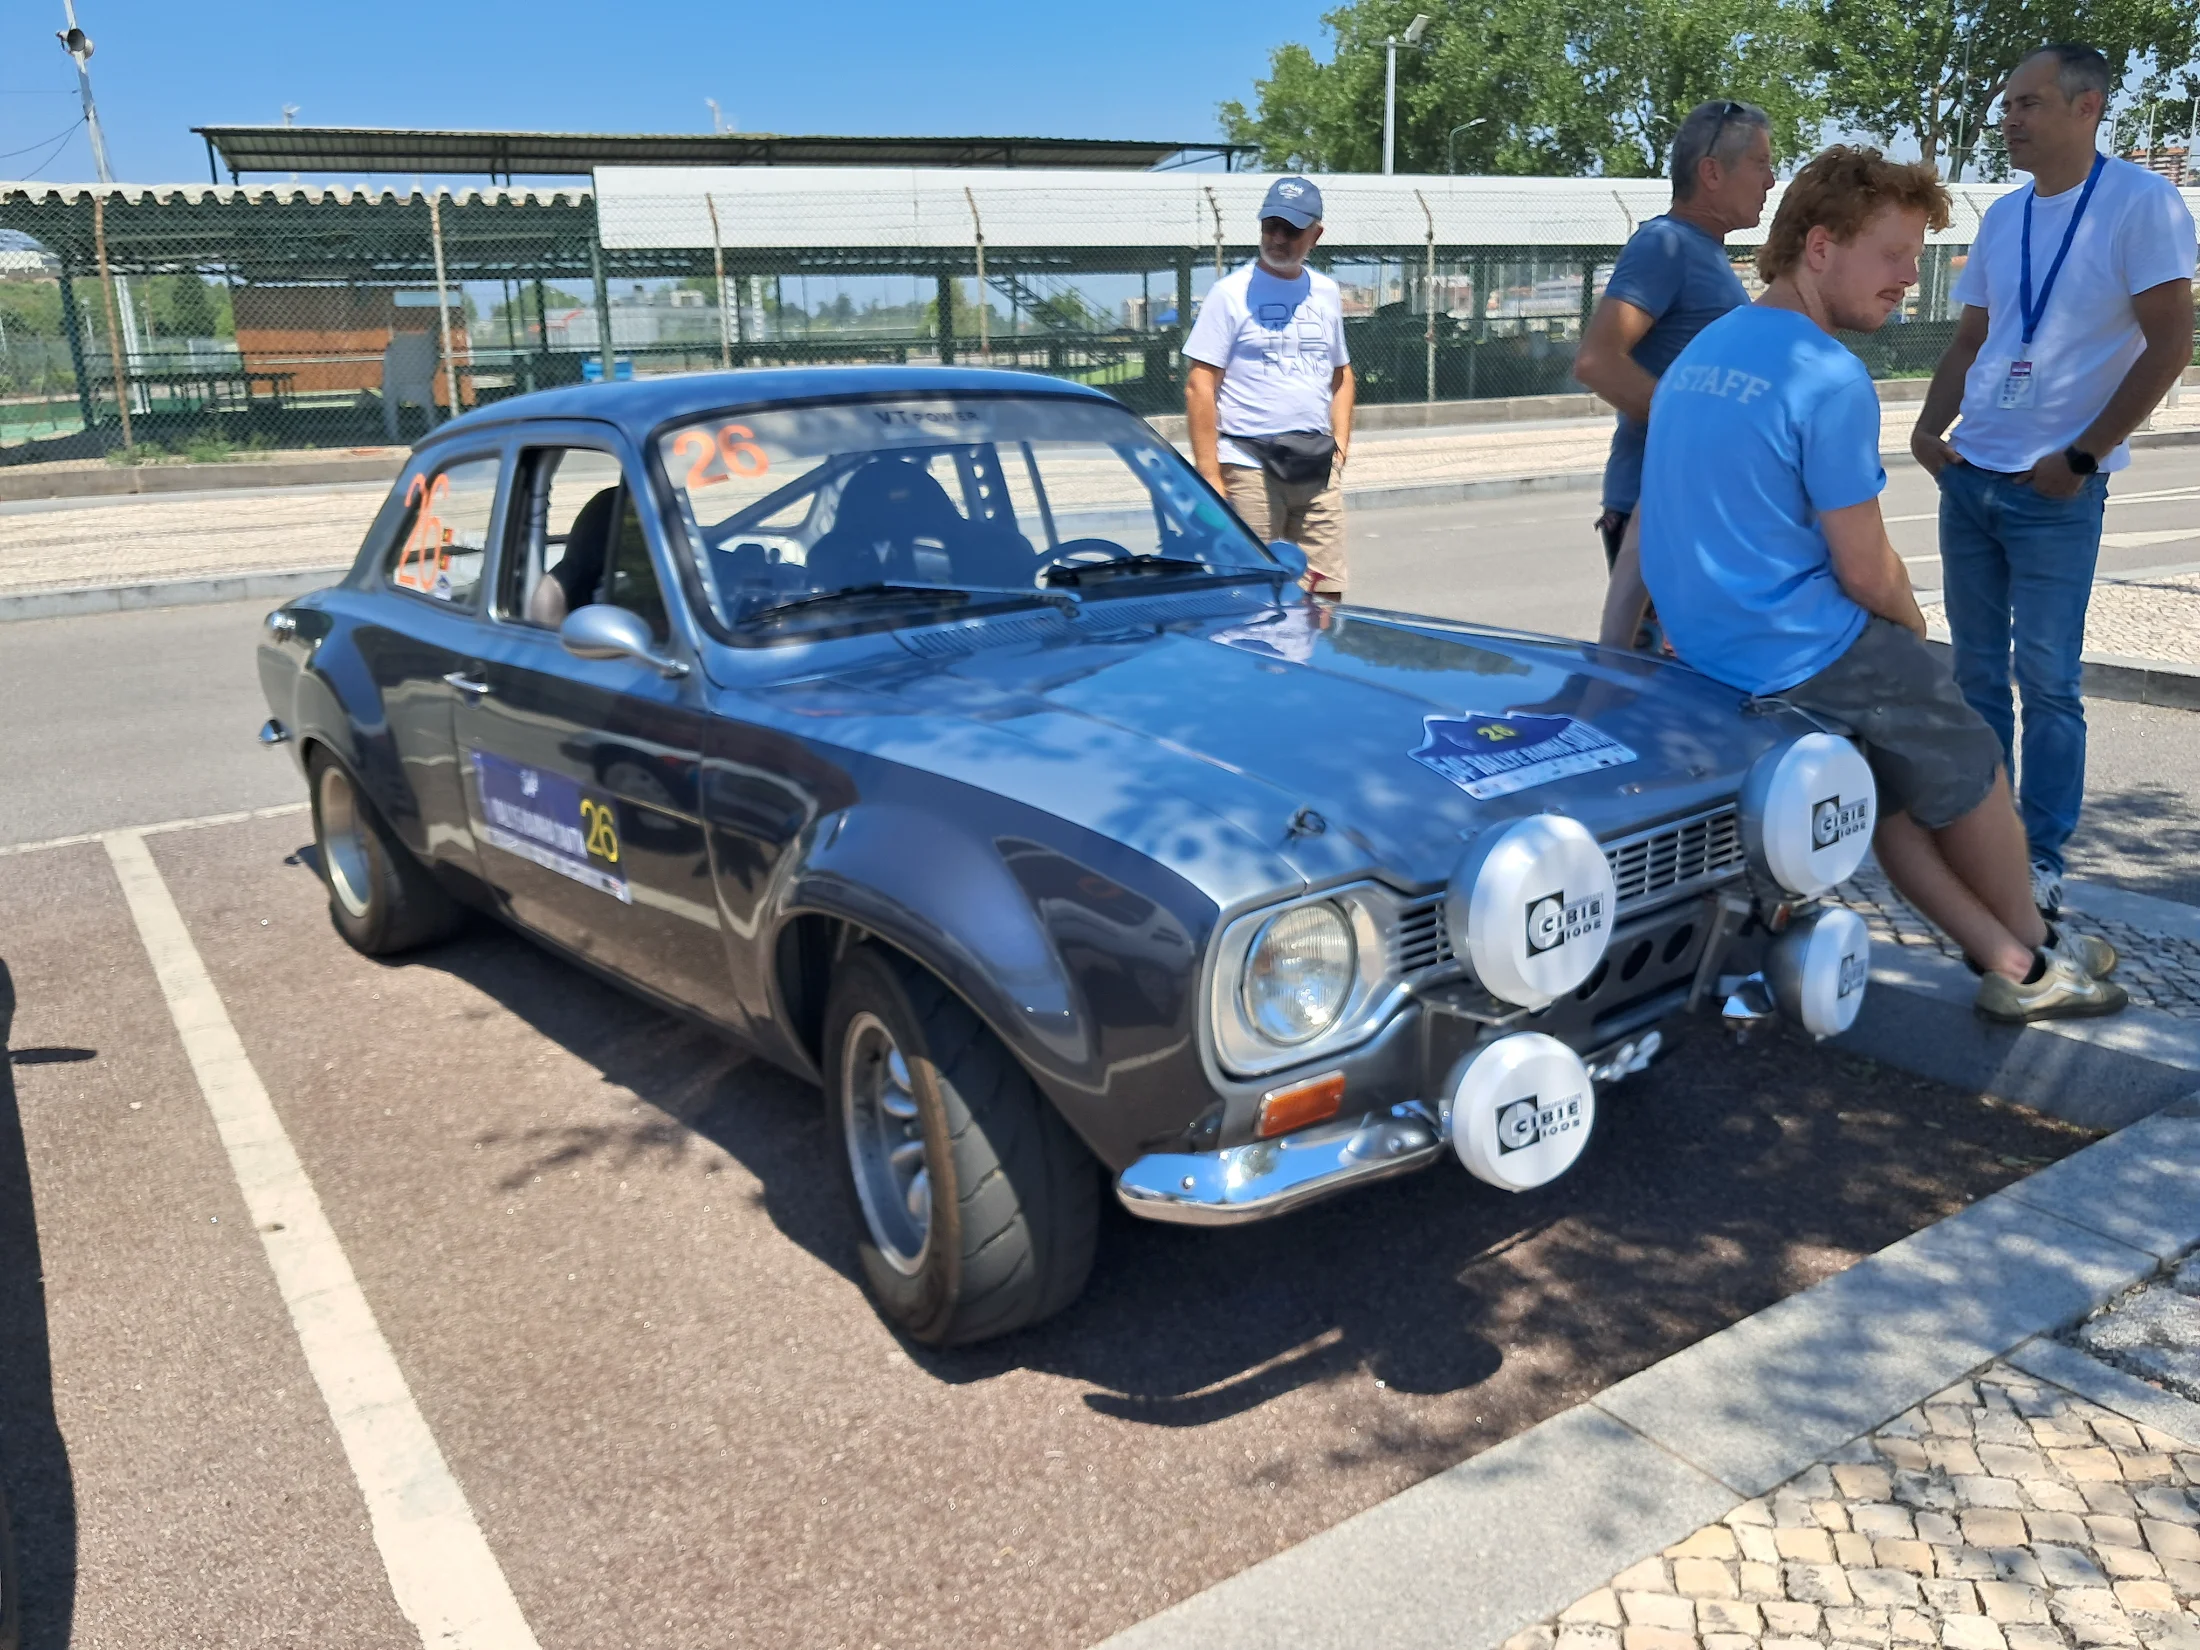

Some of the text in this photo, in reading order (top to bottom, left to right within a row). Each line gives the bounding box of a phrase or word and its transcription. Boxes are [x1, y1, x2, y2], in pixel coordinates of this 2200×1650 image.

[1673, 365, 1772, 404] STAFF
[673, 424, 769, 489] 26
[398, 472, 449, 591] 26
[1477, 723, 1518, 742] 26
[579, 798, 619, 863] 26
[1514, 1100, 1579, 1134] CIBIE
